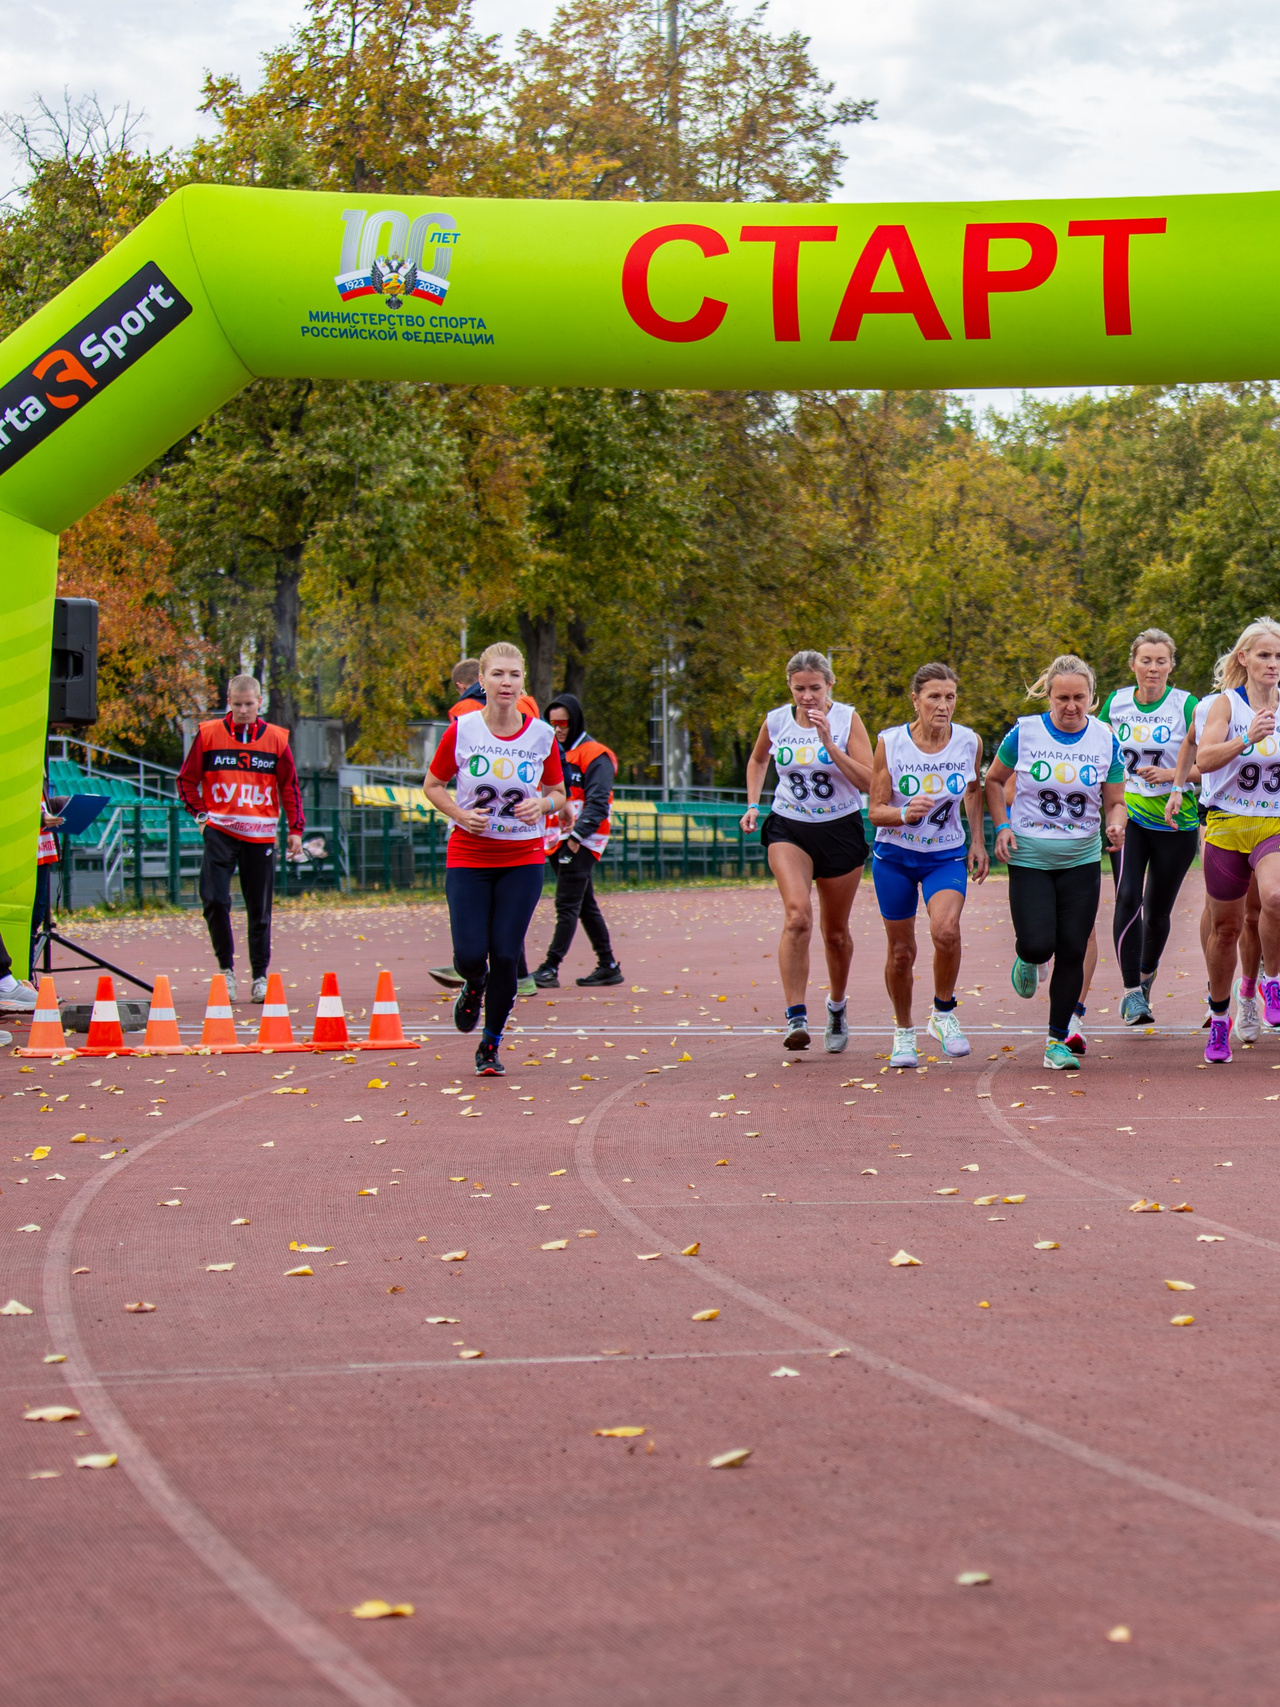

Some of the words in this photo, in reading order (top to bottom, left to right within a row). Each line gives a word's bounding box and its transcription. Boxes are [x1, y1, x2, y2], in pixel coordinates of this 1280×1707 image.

[429, 232, 461, 244] ЛЕТ
[344, 279, 365, 291] 1923
[418, 281, 441, 296] 2023
[621, 217, 1167, 343] СТАРТ
[308, 310, 425, 328] МИНИСТЕРСТВО
[429, 315, 487, 330] СПОРТА
[300, 325, 398, 341] РОССИЙСКОЙ
[401, 331, 495, 346] ФЕДЕРАЦИИ
[0, 395, 47, 450] rta
[79, 284, 175, 369] Sport
[777, 734, 839, 746] VMARAFE
[214, 756, 237, 766] Arta
[469, 745, 538, 761] VMARAFONE
[1030, 750, 1100, 764] VMARAFONE
[1122, 747, 1166, 775] 27
[898, 762, 966, 773] VMARAFONE
[211, 782, 273, 808] СУДЬЯ
[787, 770, 836, 801] 88
[472, 783, 526, 819] 22
[1037, 787, 1089, 820] 89
[904, 799, 956, 831] 4
